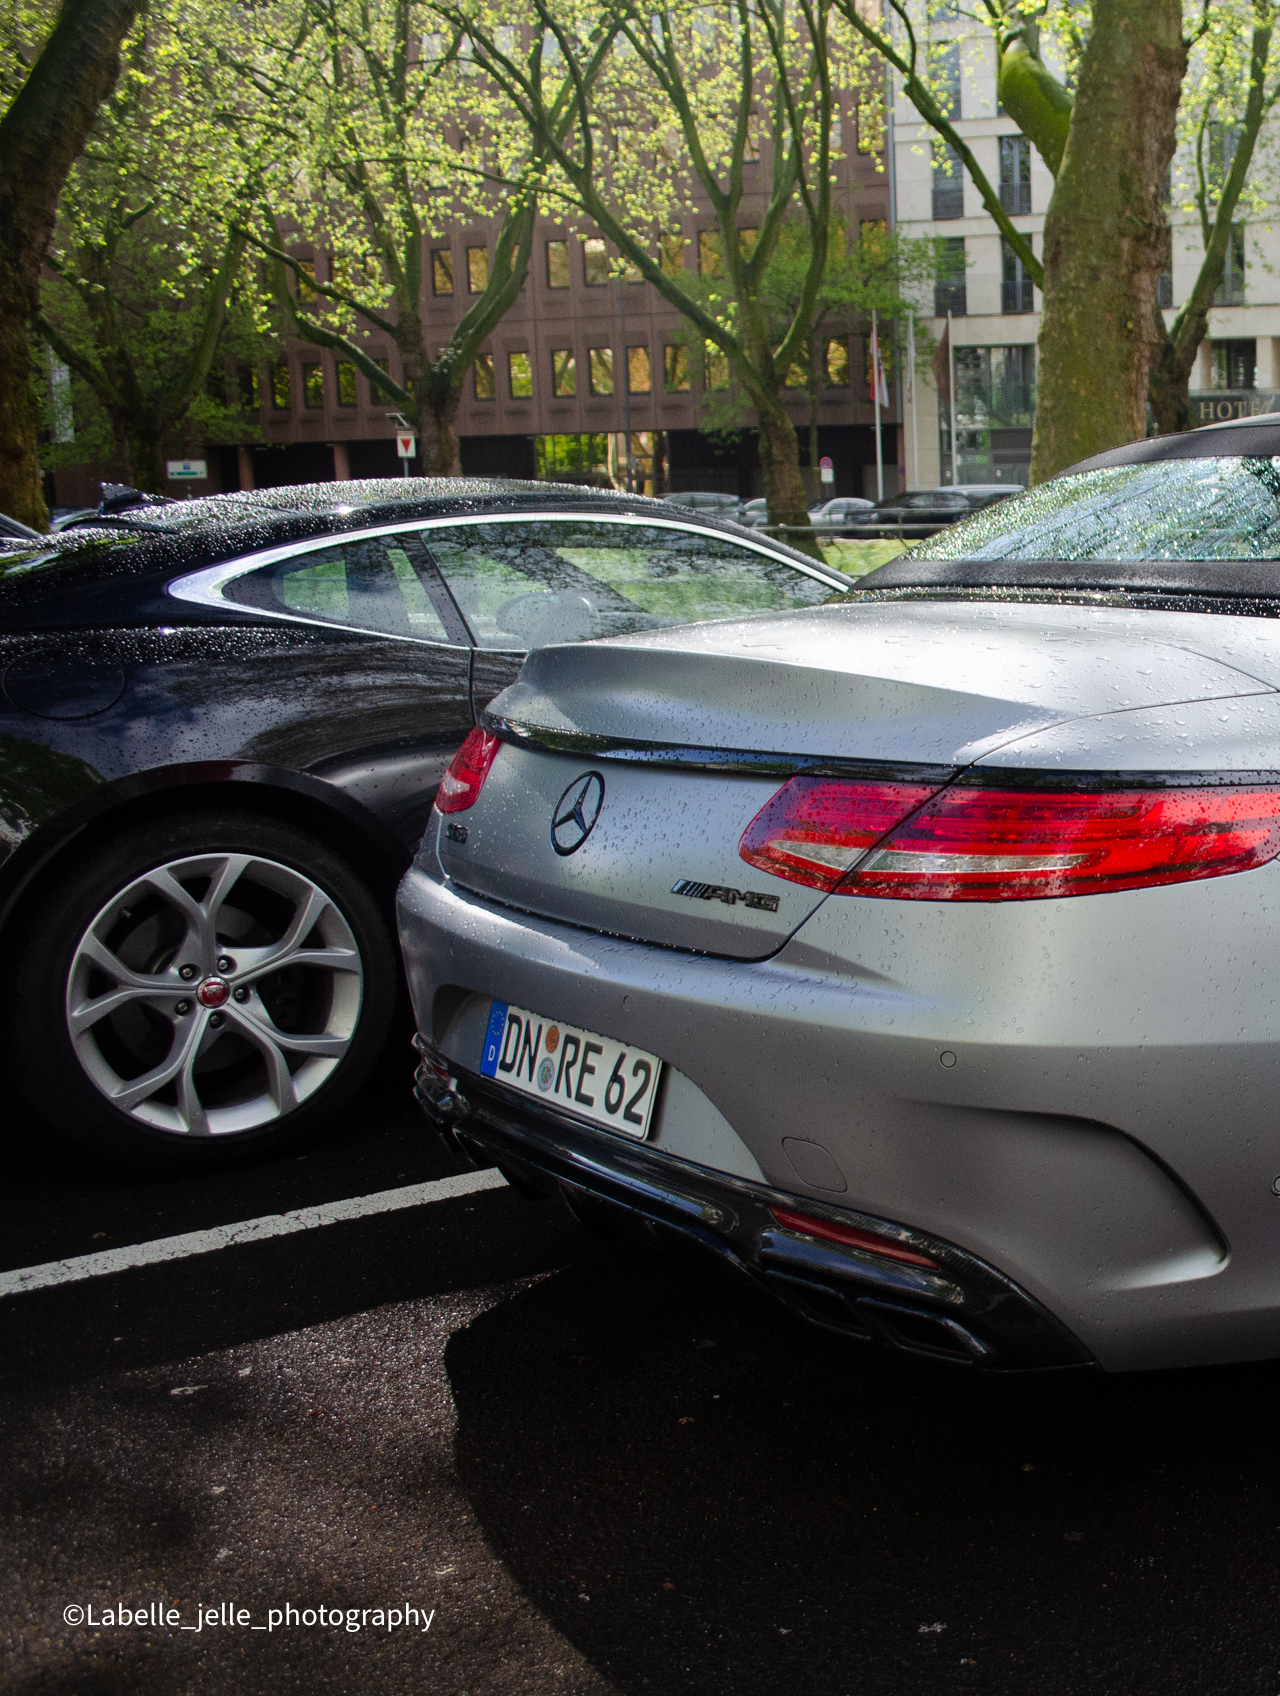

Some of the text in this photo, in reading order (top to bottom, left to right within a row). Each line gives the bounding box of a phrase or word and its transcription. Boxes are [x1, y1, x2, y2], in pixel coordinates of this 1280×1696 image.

[1200, 400, 1271, 419] HOTEL
[488, 1045, 496, 1062] D
[499, 1013, 652, 1125] DN RE 62
